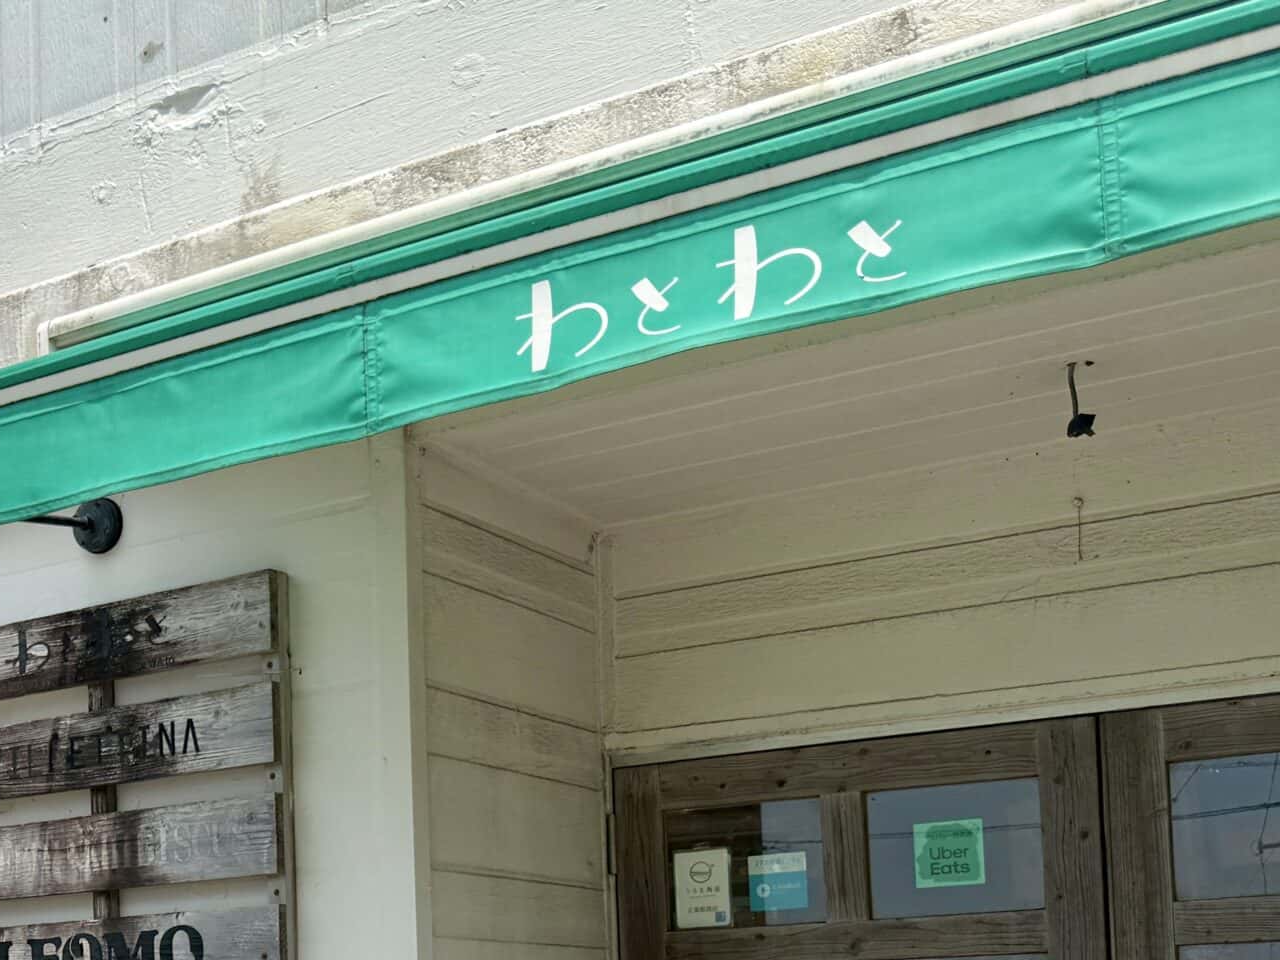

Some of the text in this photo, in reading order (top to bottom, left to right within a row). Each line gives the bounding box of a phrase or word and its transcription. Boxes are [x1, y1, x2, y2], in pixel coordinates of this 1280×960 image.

[515, 219, 908, 373] わとわと
[928, 846, 969, 860] Uber
[930, 861, 971, 876] Eats
